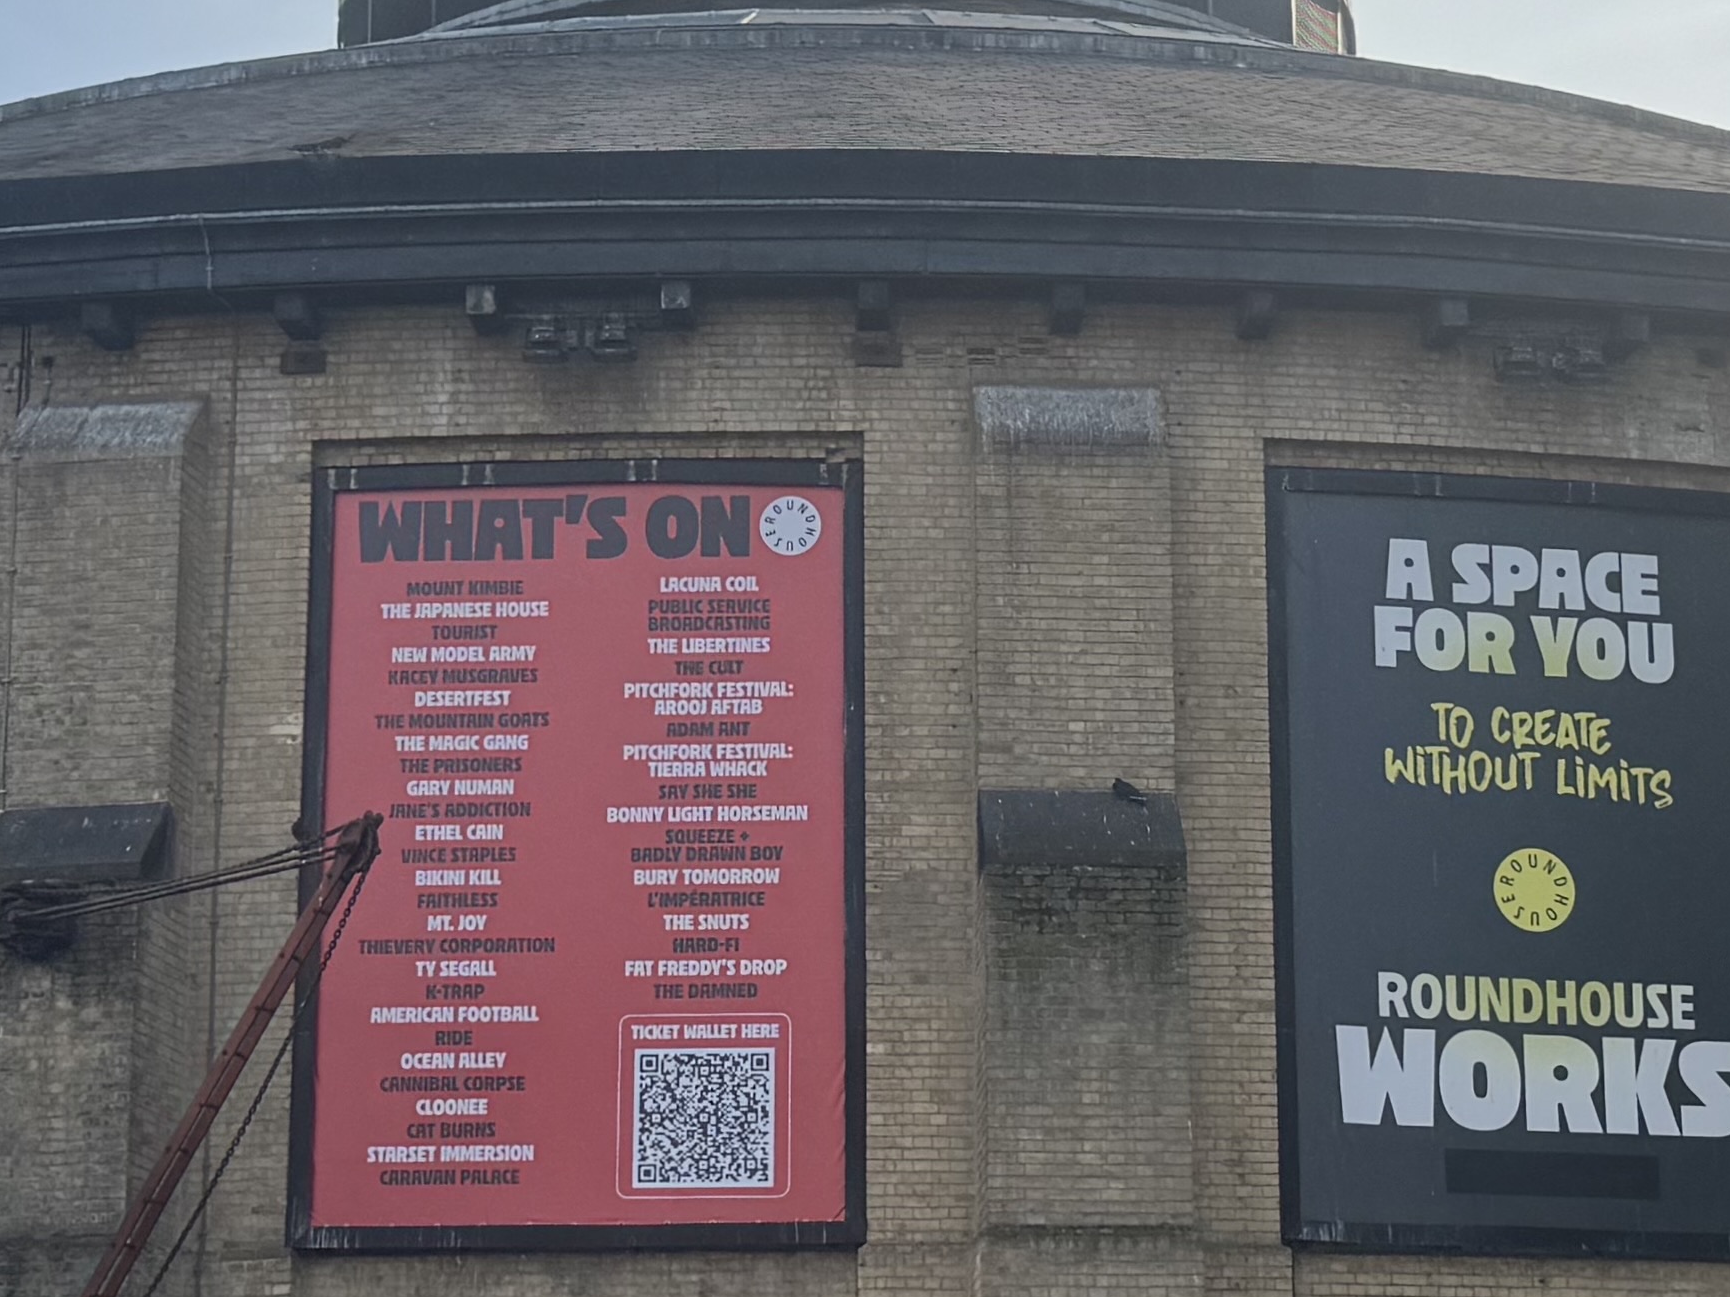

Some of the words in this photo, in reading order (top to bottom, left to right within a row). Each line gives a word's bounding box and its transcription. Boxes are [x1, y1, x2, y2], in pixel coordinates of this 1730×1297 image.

[359, 495, 628, 563] WHAT'S
[646, 495, 750, 558] ON
[764, 499, 817, 553] ROUNDHOUSE
[660, 577, 721, 592] LACUNA
[726, 576, 759, 591] COIL
[1384, 538, 1432, 602] A
[1452, 543, 1660, 616] SPACE
[407, 581, 464, 596] MOUNT
[468, 580, 523, 595] KIMBIE
[381, 603, 411, 619] THE
[414, 602, 491, 618] JAPANESE
[496, 601, 548, 617] HOUSE
[648, 599, 703, 614] PUBLIC
[707, 599, 770, 615] SERVICE
[648, 616, 770, 631] BROADCASTING
[432, 625, 498, 640] TOURIST
[648, 638, 677, 654] THE
[682, 637, 770, 653] LIBERTINES
[1373, 605, 1516, 677] FOR
[1529, 615, 1674, 685] YOU
[392, 647, 427, 663] NEW
[431, 647, 485, 662] MODEL
[489, 646, 536, 661] ARMY
[675, 661, 703, 675] THE
[709, 660, 743, 675] CULT
[388, 669, 438, 685] KACEY
[443, 668, 538, 683] MUSGRAVES
[624, 682, 713, 698] PITCHFORK
[717, 682, 793, 697] FESTIVAL:
[415, 690, 511, 707] DESERTFEST
[655, 700, 707, 715] AROOJ
[711, 699, 762, 715] AFTAB
[375, 714, 404, 729] THE
[409, 713, 494, 728] MOUNTAIN
[498, 713, 549, 728] GOATS
[1430, 702, 1474, 749] TO
[1490, 705, 1612, 755] CREATE
[667, 722, 713, 737] ADAM
[719, 722, 750, 736] ANT
[395, 736, 425, 751] THE
[429, 735, 479, 751] MAGIC
[483, 735, 528, 750] GANG
[624, 744, 712, 760] PITCHFORK
[717, 744, 793, 759] FESTIVAL:
[400, 758, 429, 773] THE
[433, 757, 522, 773] PRISONERS
[648, 761, 705, 777] TIERRA
[710, 761, 767, 776] WHACK
[407, 780, 450, 796] GARY
[455, 779, 514, 795] NUMAN
[659, 784, 688, 799] SAY
[693, 784, 722, 799] SHE
[727, 784, 756, 799] SHE
[389, 802, 440, 818] JANE'S
[445, 802, 530, 818] ADDICTION
[607, 807, 664, 823] BONNY
[668, 806, 713, 822] LIGHT
[718, 805, 807, 821] HORSEMAN
[415, 825, 463, 840] ETHEL
[467, 824, 503, 839] CAIN
[665, 829, 735, 845] SQUEEZE
[401, 848, 446, 863] VINCE
[451, 847, 516, 862] STAPLES
[631, 847, 681, 862] BADLY
[686, 845, 746, 861] DRAWN
[750, 846, 783, 861] BOY
[415, 870, 465, 886] BIKINI
[469, 869, 501, 885] KILL
[634, 869, 678, 885] BURY
[682, 868, 780, 884] TOMORROW
[1499, 853, 1570, 926] ROUNDHOUSE
[417, 892, 498, 908] FAITHLESS
[427, 915, 454, 931] MT.
[458, 915, 487, 930] JOY
[663, 915, 694, 930] THE
[698, 914, 749, 930] SNUTS
[358, 939, 435, 954] THIEVERY
[440, 937, 555, 954] CORPORATION
[673, 937, 739, 953] HARD-FI
[416, 961, 436, 977] TY
[440, 960, 496, 976] SEGALL
[625, 961, 654, 976] FAT
[658, 959, 736, 976] FREDDY'S
[740, 959, 787, 975] DROP
[426, 984, 484, 999] K-TRAP
[654, 984, 683, 999] THE
[688, 983, 757, 999] DAMNED
[1377, 971, 1696, 1030] ROUNDHOUSE
[371, 1007, 454, 1023] AMERICAN
[458, 1006, 539, 1022] FOOTBALL
[435, 1031, 472, 1045] RIDE
[631, 1025, 680, 1039] TICKET
[684, 1024, 737, 1039] WALLET
[741, 1024, 779, 1038] HERE
[401, 1053, 454, 1069] OCEAN
[459, 1052, 506, 1068] ALLEY
[380, 1076, 459, 1092] CANNIBAL
[463, 1076, 525, 1091] CORPSE
[416, 1099, 487, 1115] CLOONEE
[407, 1123, 435, 1138] CAT
[440, 1122, 495, 1138] BURNS
[367, 1146, 436, 1162] STARSET
[440, 1145, 534, 1162] IMMERSION
[380, 1169, 456, 1185] CARAVAN
[460, 1169, 519, 1185] PALACE
